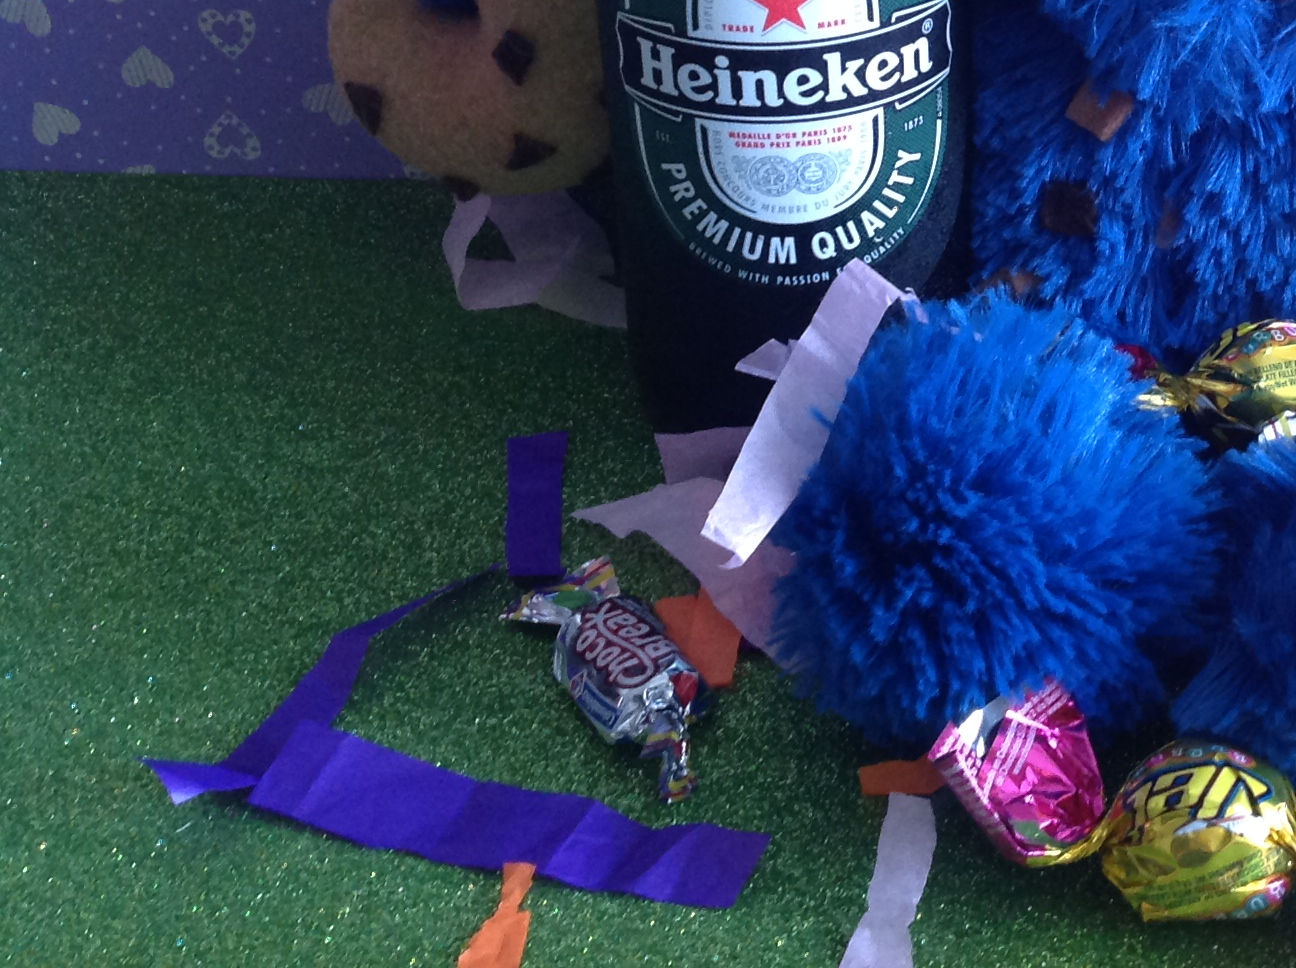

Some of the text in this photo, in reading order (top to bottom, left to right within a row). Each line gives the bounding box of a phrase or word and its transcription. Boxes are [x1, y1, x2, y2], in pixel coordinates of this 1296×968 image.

[721, 18, 846, 33] TRADE MARK
[636, 35, 934, 108] Heineken
[904, 115, 924, 132] 1873
[660, 148, 922, 265] PREMIUM QUALITY
[688, 240, 732, 274] BREWED
[738, 269, 769, 285] WITH
[776, 271, 830, 287] PASSION
[864, 228, 905, 264] QUALITY
[576, 627, 655, 687] Choco
[586, 602, 674, 669] Break
[1124, 760, 1271, 846] Jet
